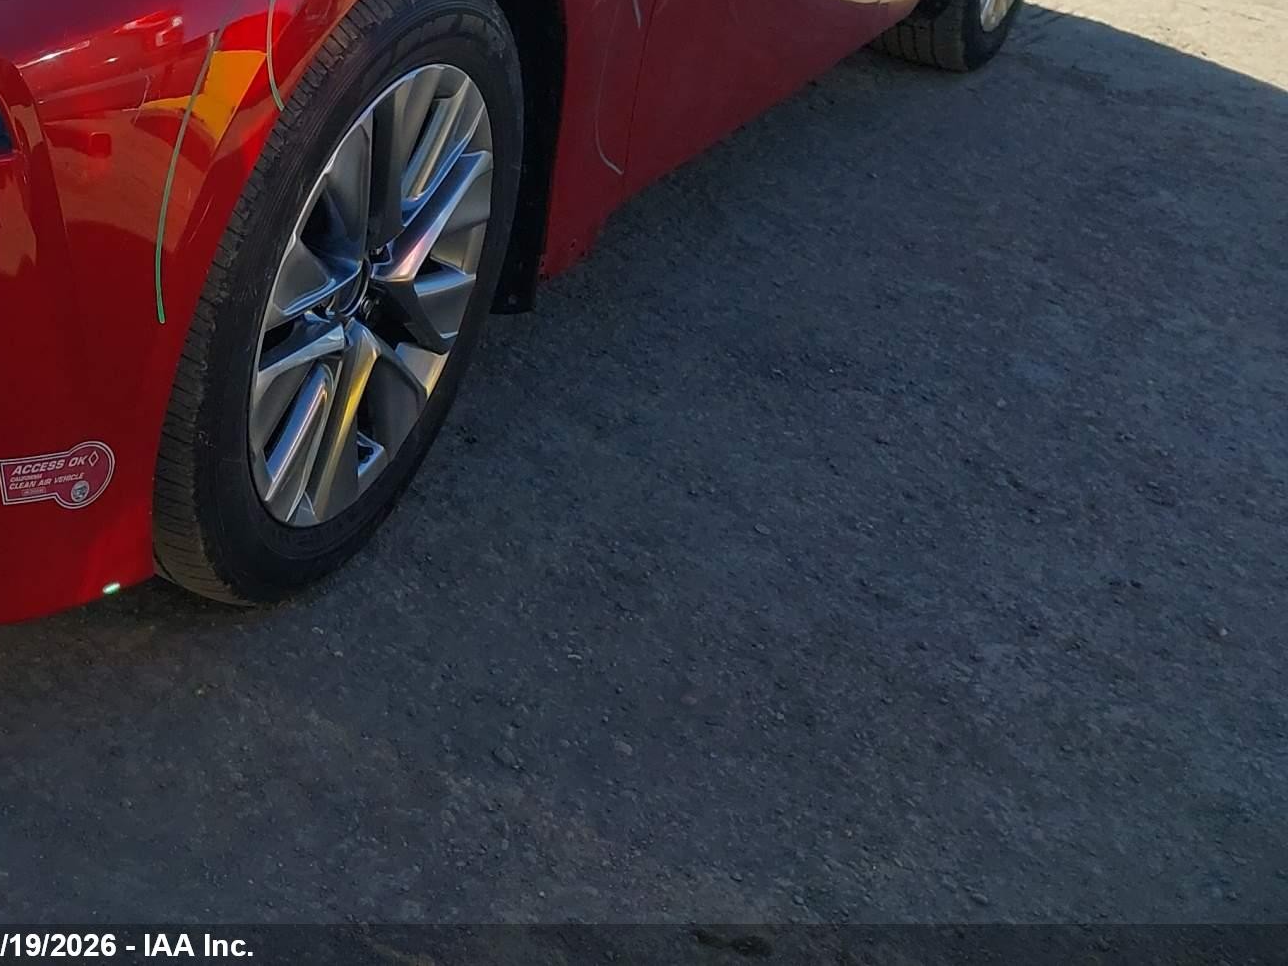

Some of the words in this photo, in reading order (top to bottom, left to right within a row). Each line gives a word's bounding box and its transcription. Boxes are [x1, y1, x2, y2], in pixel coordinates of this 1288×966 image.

[11, 459, 65, 475] ACCESS
[68, 455, 88, 467] OK
[9, 480, 37, 491] CLEAN
[37, 478, 52, 487] AIR
[54, 472, 85, 483] VEHICLE
